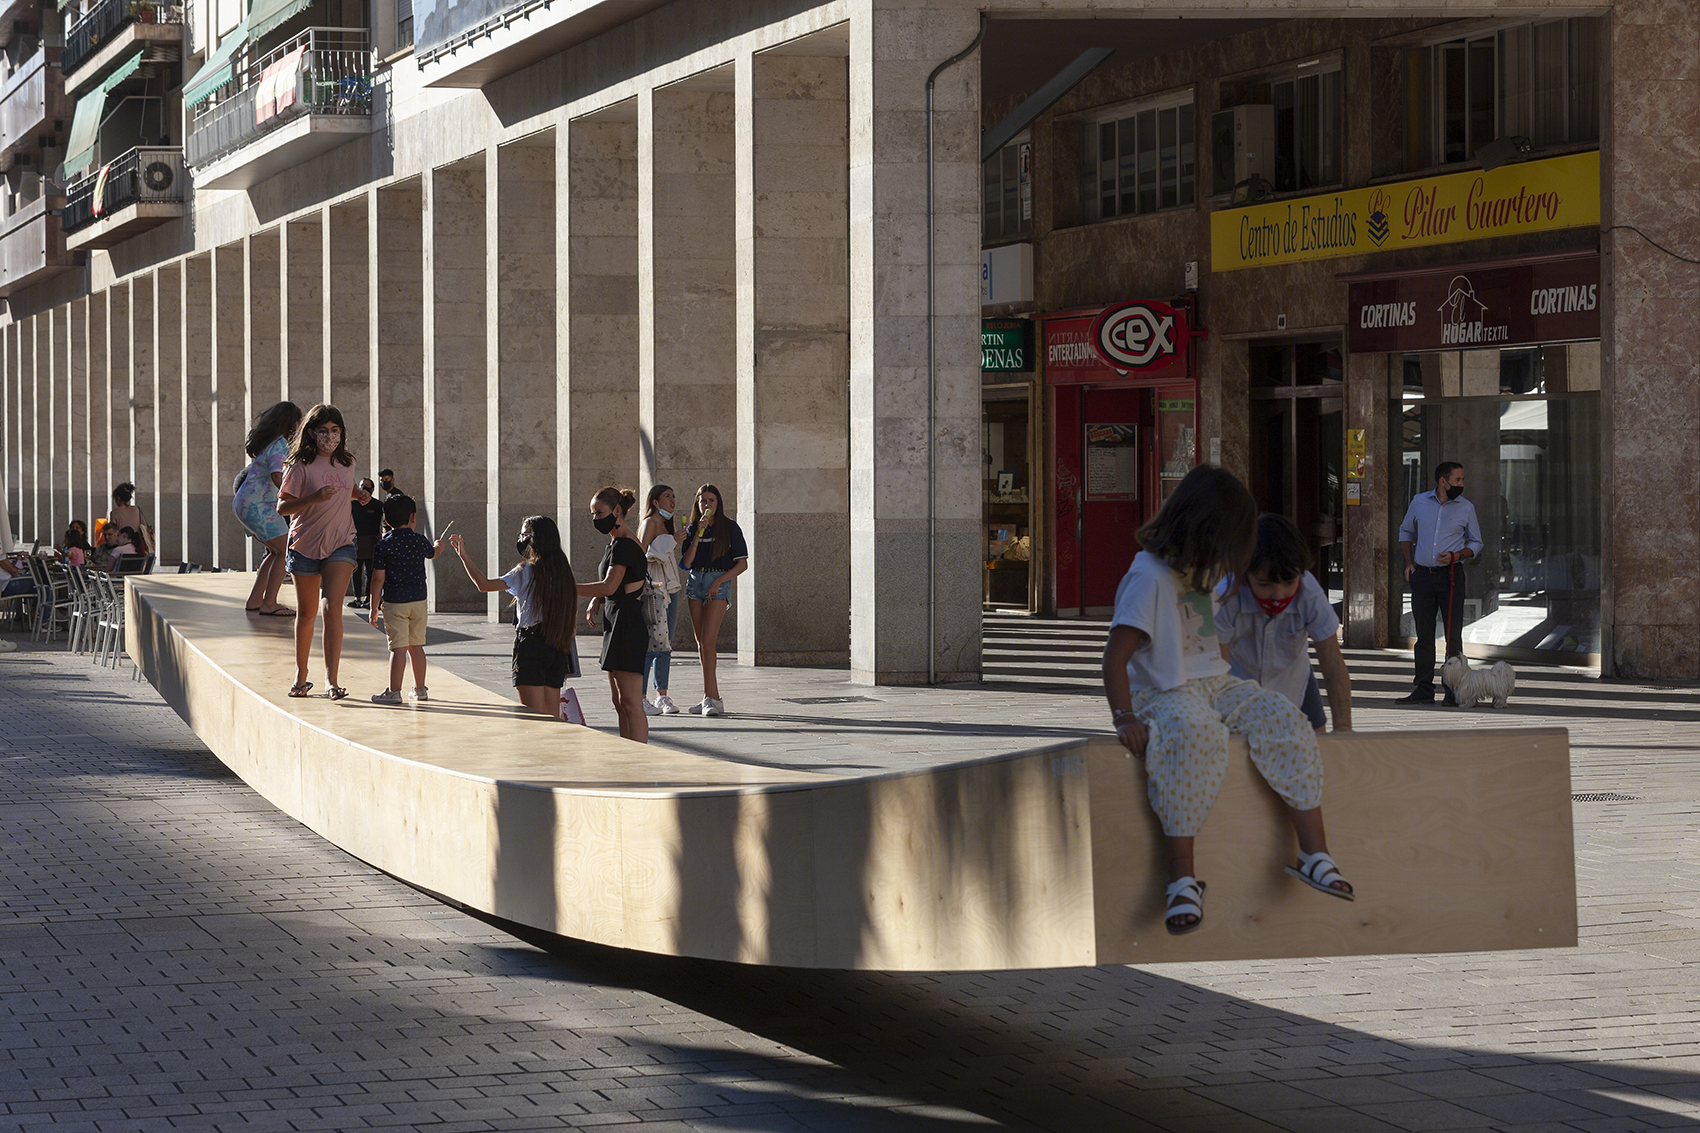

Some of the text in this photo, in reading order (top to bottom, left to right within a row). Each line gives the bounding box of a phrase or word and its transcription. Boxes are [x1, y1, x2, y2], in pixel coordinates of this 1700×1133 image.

[1401, 177, 1562, 239] Pilar Cuartero
[1240, 197, 1357, 260] Centro de Estudios
[1530, 283, 1597, 315] CORTINAS
[985, 322, 1022, 330] RELOJERIA
[1360, 301, 1416, 329] CORTINAS
[1442, 321, 1509, 345] HOGAR TEXTIL
